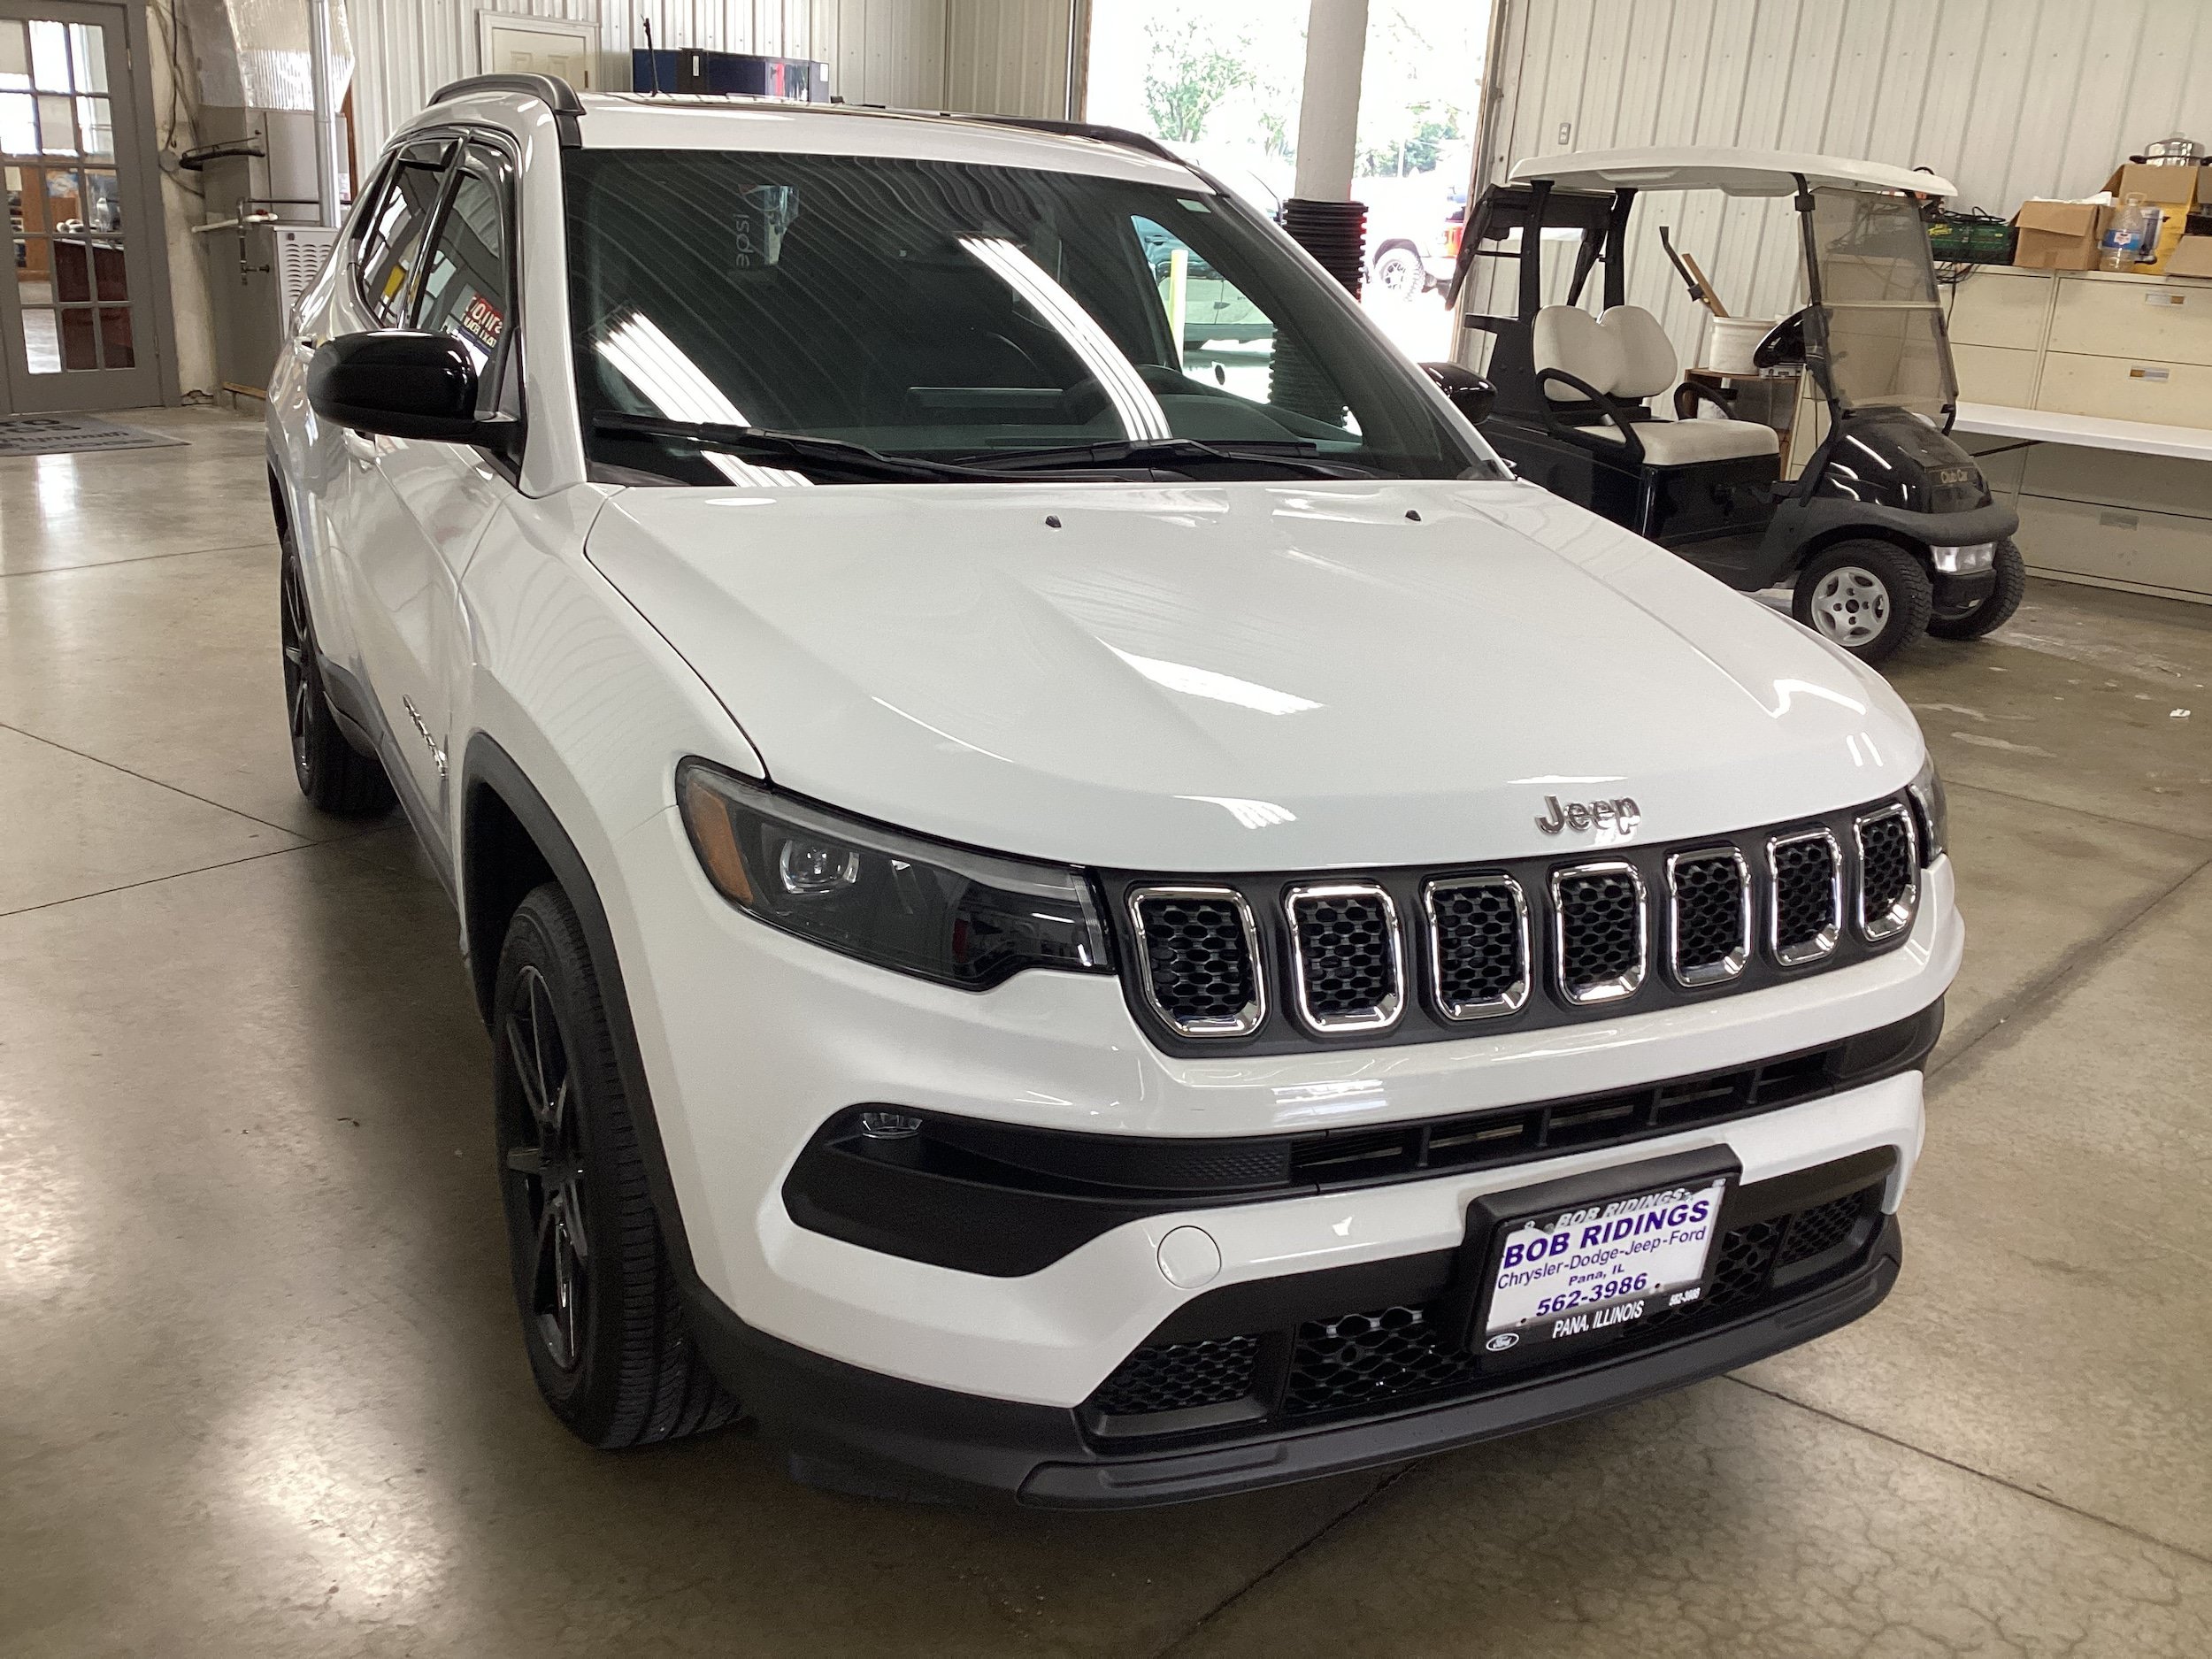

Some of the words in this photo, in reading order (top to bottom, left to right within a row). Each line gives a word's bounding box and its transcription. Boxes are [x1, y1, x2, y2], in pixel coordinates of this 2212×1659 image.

[1534, 795, 1641, 835] Jeep
[1555, 1207, 1601, 1228] BOB
[1602, 1188, 1686, 1218] RIDINGS
[1503, 1233, 1571, 1269] BOB
[1579, 1201, 1710, 1248] RIDINGS
[1498, 1226, 1707, 1289] Chrysler-Dodge-Jeep-Ford
[1569, 1270, 1607, 1286] Pana,
[1612, 1263, 1625, 1274] IL
[1536, 1272, 1647, 1317] 562-3986
[1593, 1301, 1645, 1328] ILLINOIS
